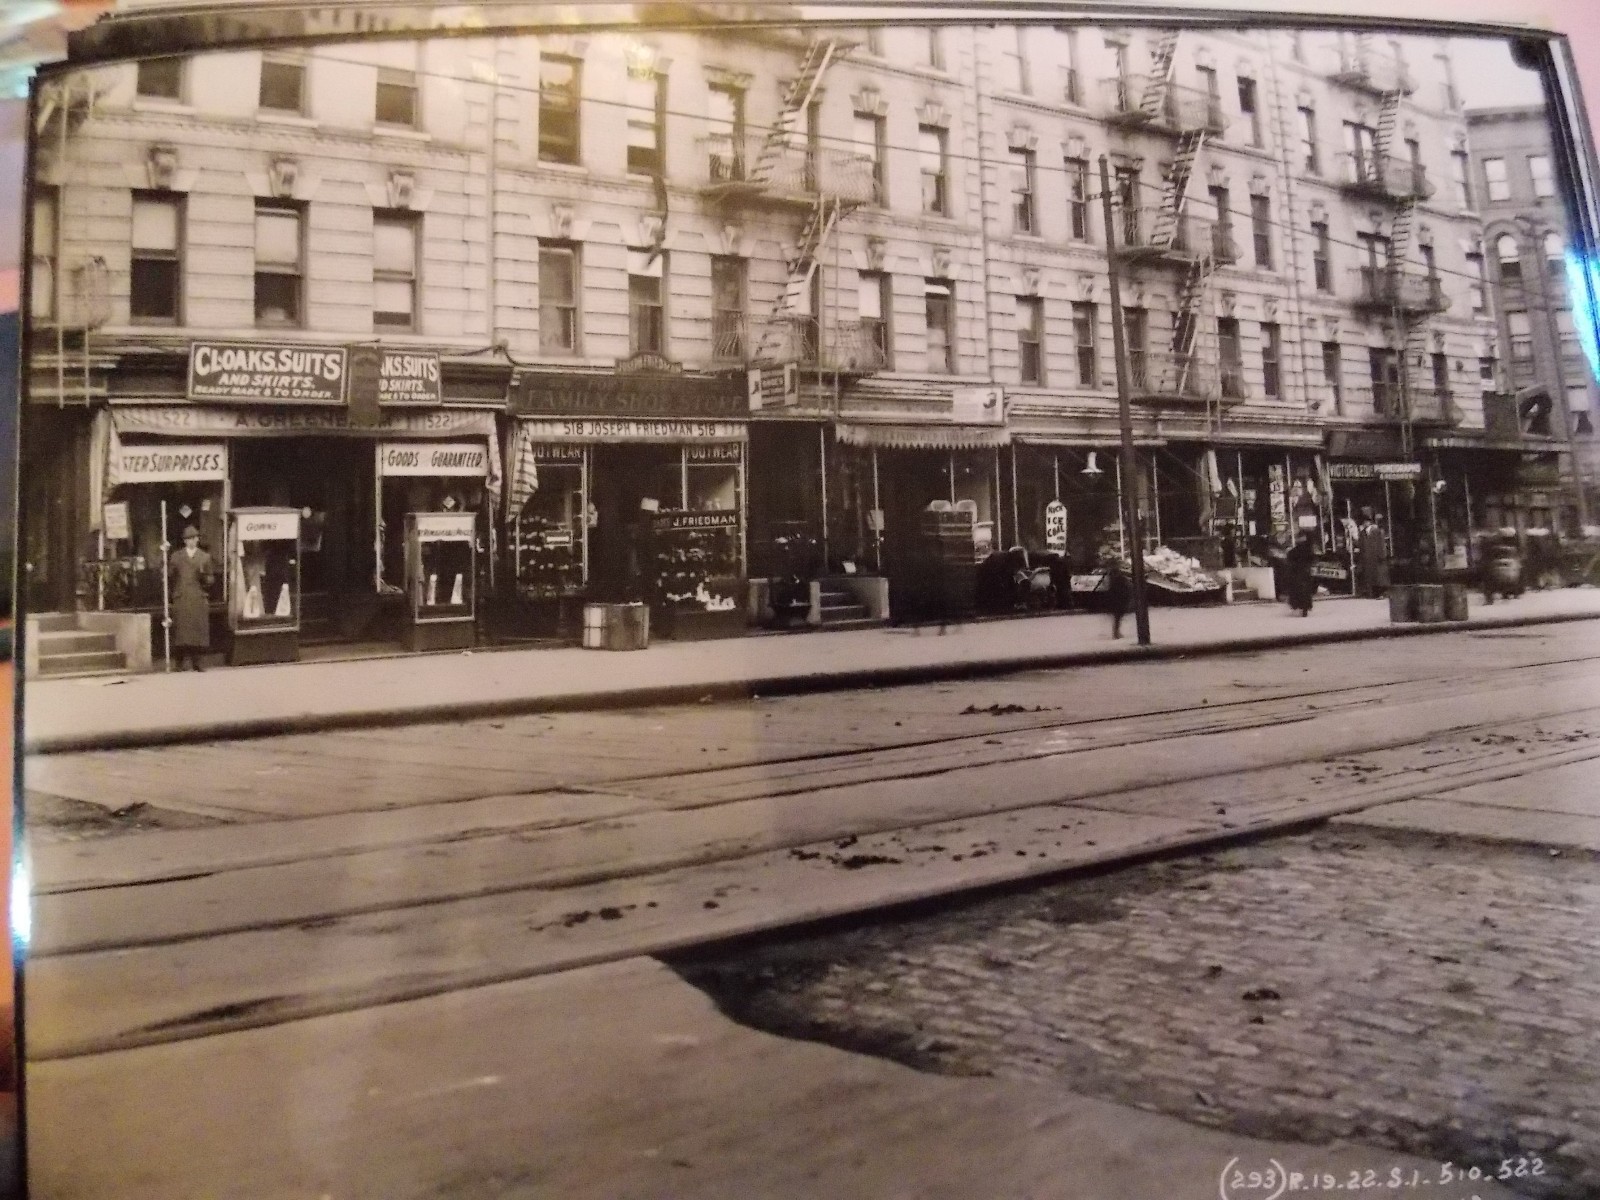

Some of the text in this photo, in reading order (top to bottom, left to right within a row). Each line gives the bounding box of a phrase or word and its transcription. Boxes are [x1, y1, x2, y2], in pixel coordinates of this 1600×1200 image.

[219, 373, 250, 386] AND
[273, 389, 290, 397] TO
[427, 414, 451, 428] 522
[564, 421, 716, 437] 518 JOSEPH FRIEDMAN 518
[388, 449, 420, 467] GOODS
[1047, 516, 1064, 525] ICE
